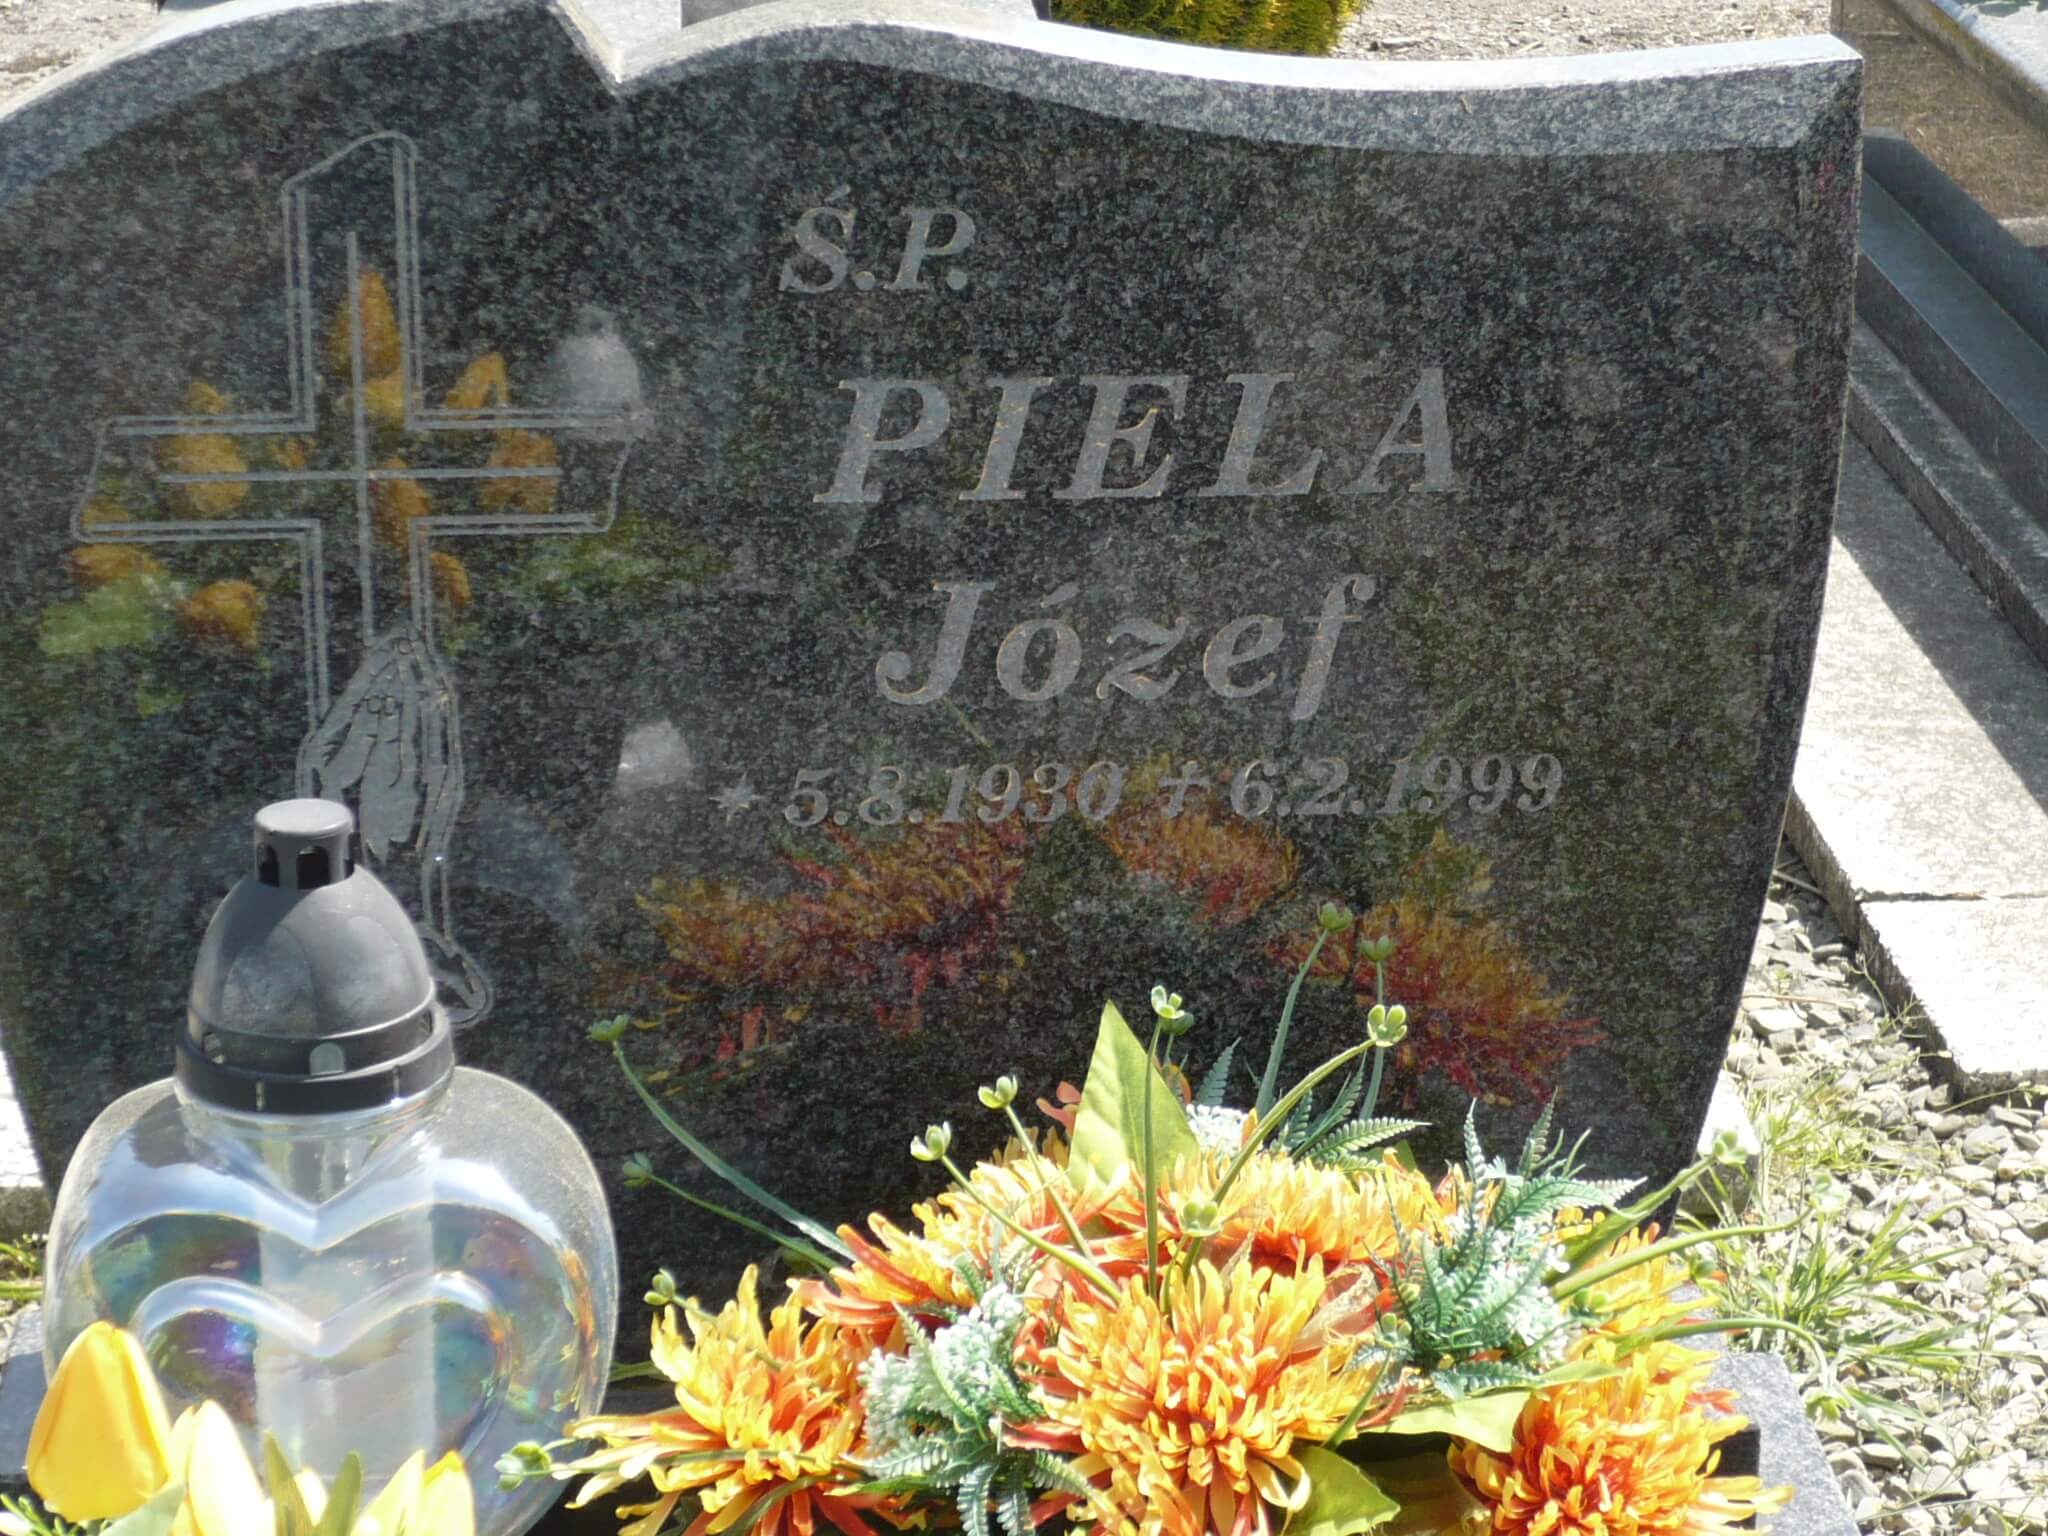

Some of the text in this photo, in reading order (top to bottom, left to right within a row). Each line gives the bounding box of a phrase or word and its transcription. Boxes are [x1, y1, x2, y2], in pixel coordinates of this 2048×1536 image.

[778, 185, 976, 294] Ś.P.
[813, 366, 1462, 504] PIELA
[875, 572, 1375, 721] Józef
[784, 753, 1563, 828] 5.8.1930 6.2.1999
